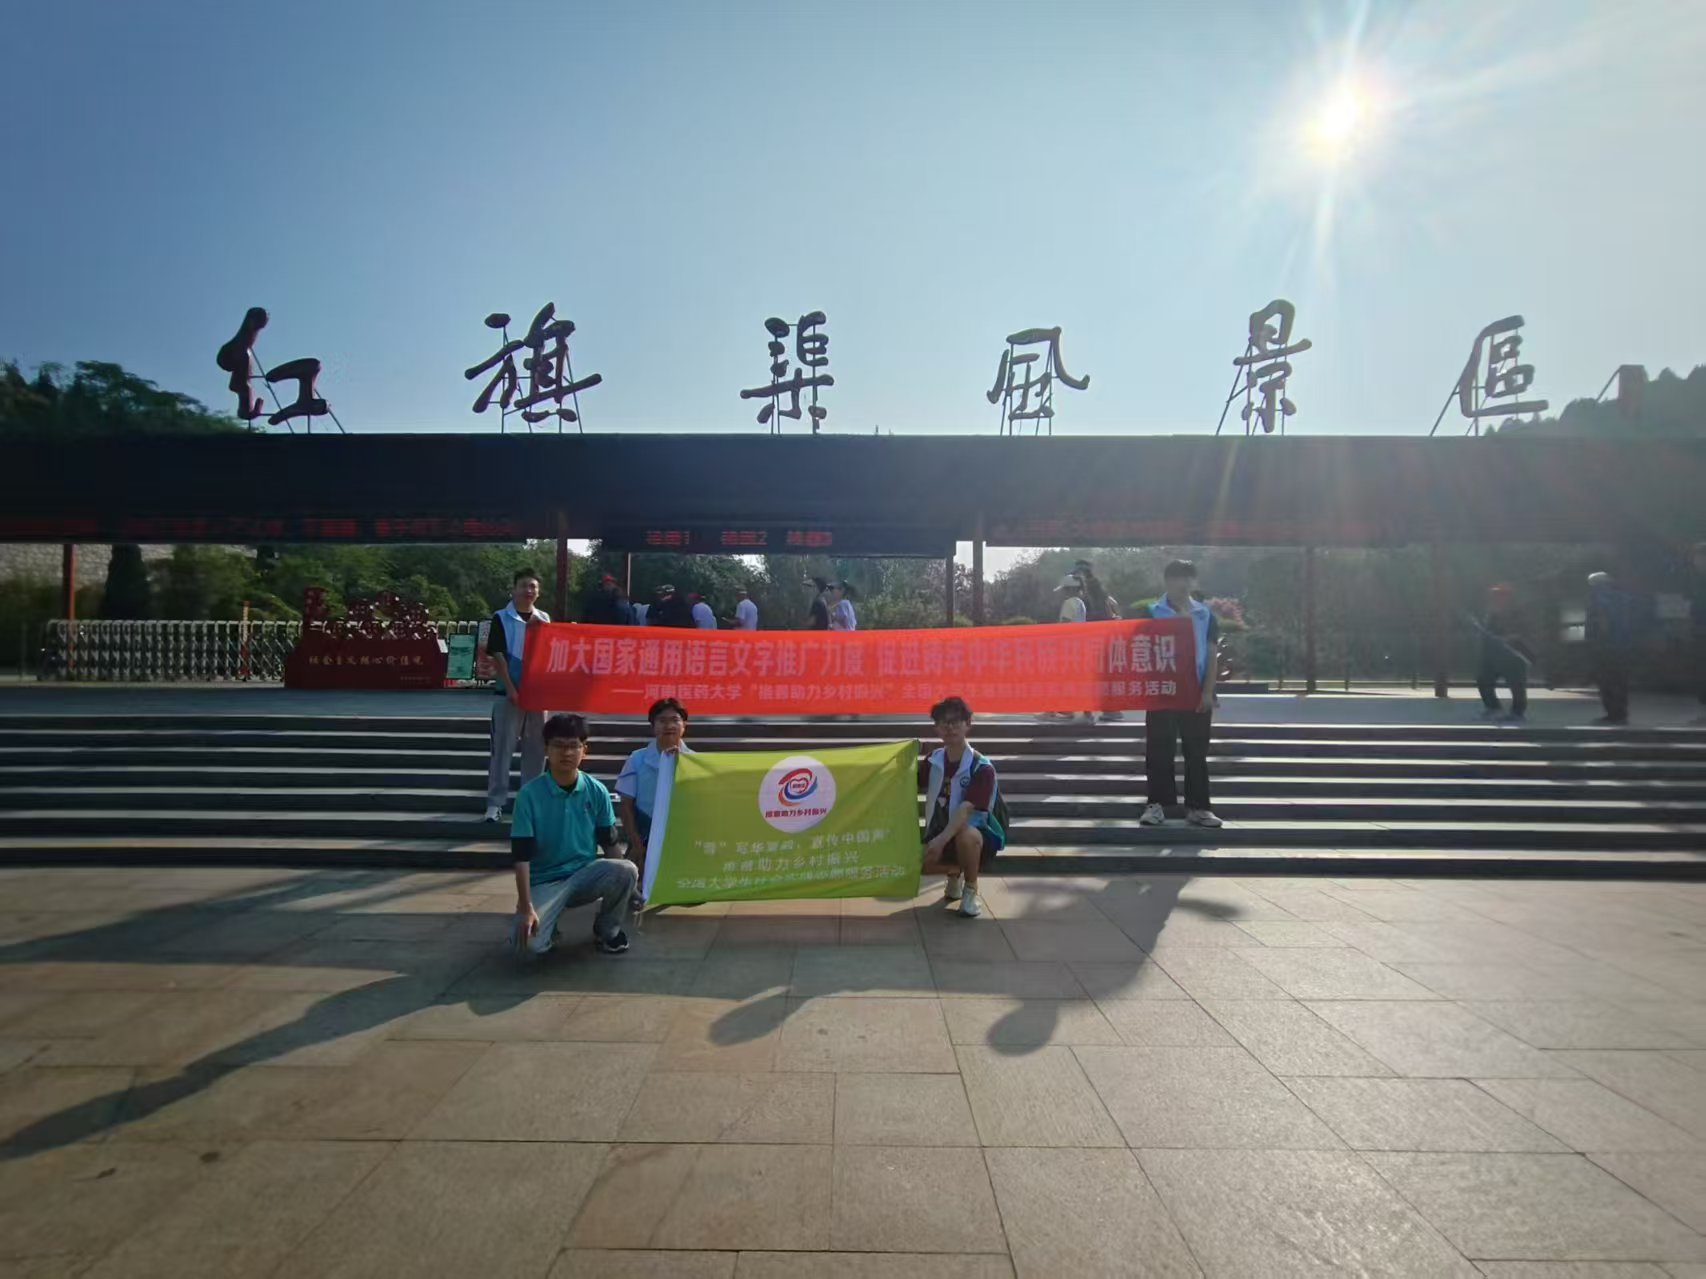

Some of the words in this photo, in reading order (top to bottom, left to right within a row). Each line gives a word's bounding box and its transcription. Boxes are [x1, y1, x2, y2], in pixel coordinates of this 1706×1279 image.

[546, 637, 865, 676] 加大国家通用语言文字推广力度
